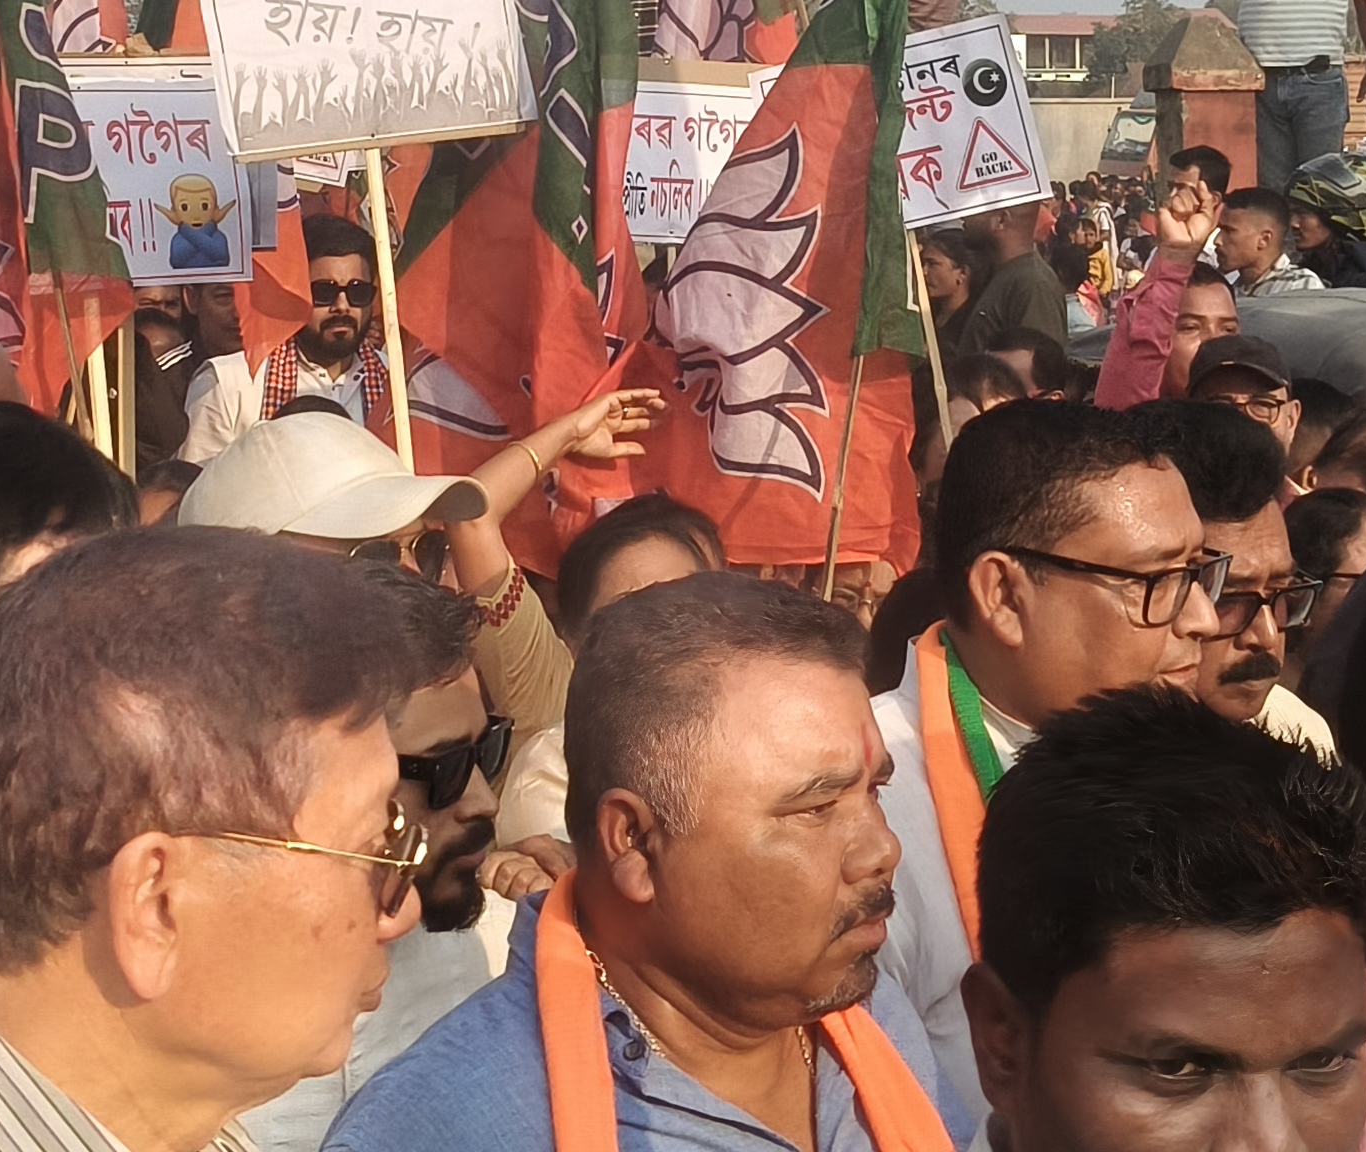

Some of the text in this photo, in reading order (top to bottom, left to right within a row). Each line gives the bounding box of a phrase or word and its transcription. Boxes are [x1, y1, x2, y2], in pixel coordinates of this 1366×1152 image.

[106, 103, 210, 165] গগৈৰ
[633, 114, 676, 150] ৰৱ
[975, 160, 1013, 178] BACK!
[981, 151, 998, 164] GO
